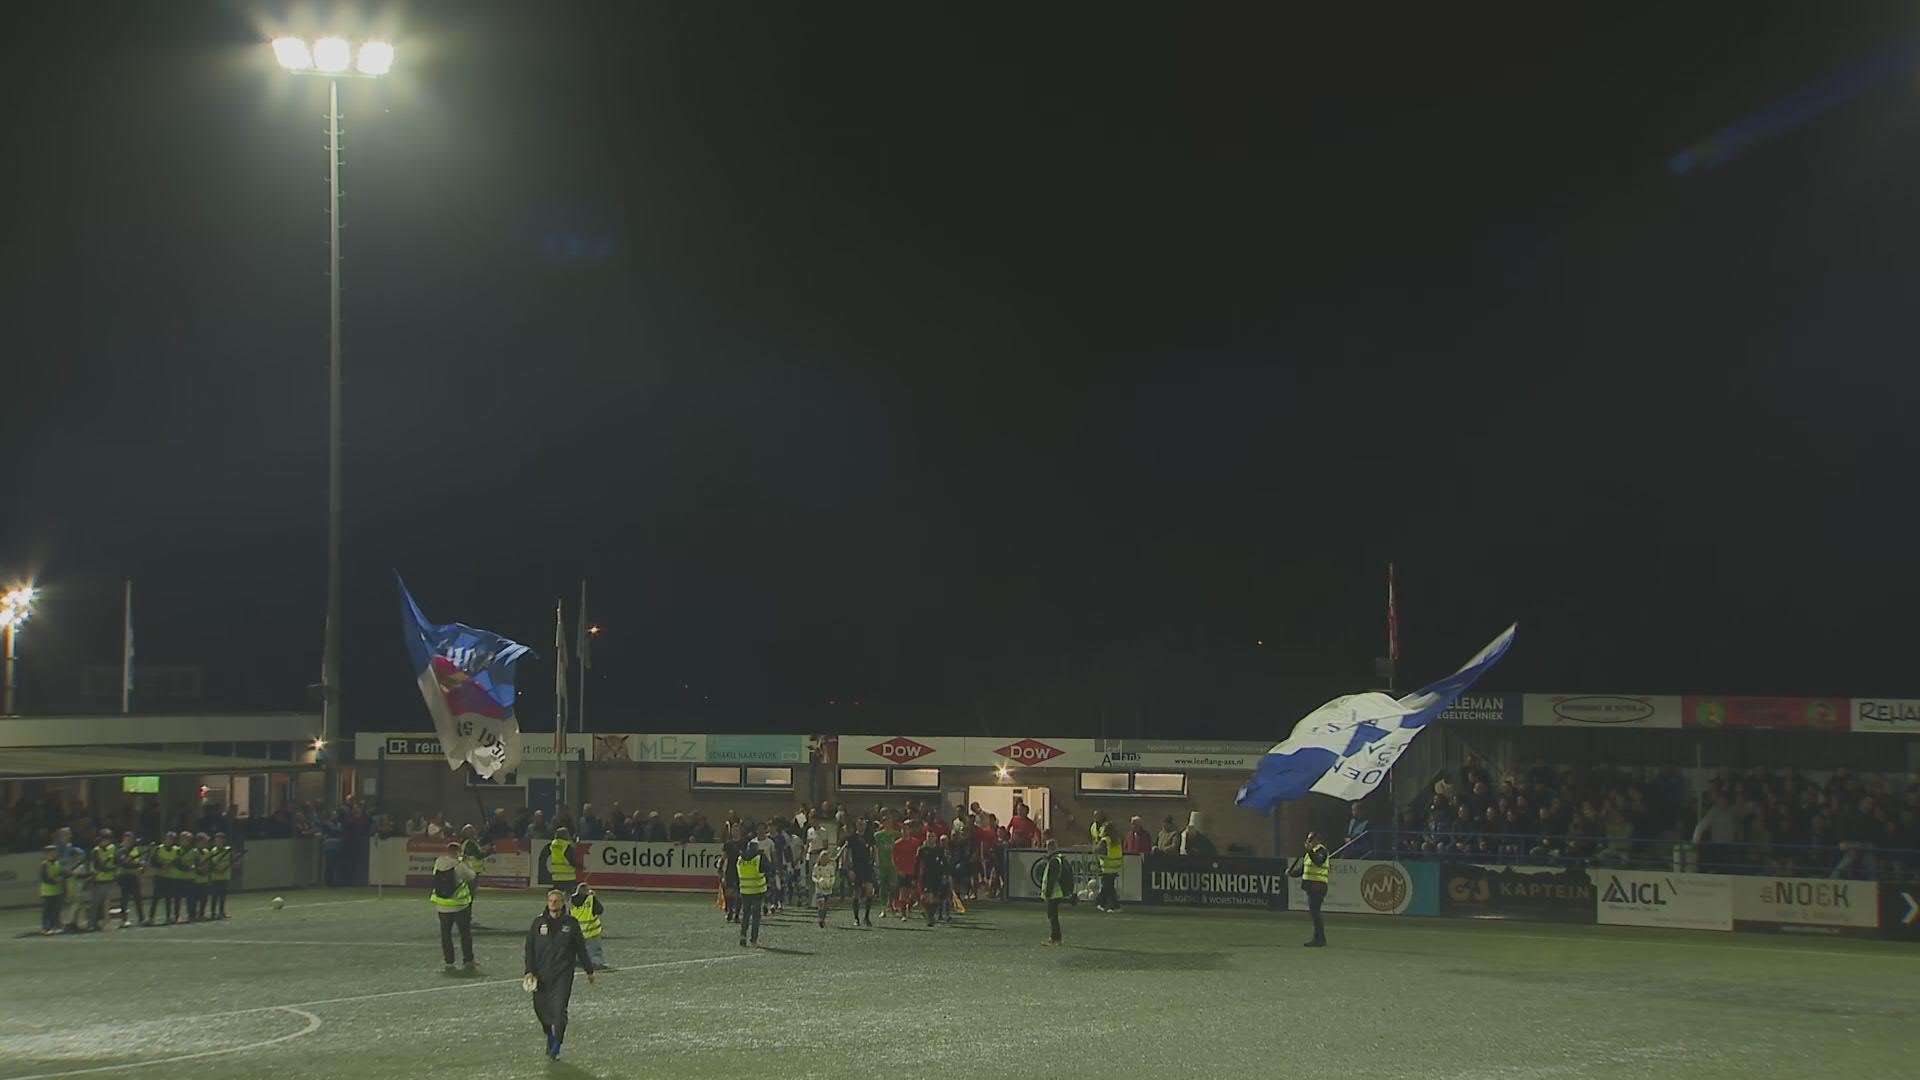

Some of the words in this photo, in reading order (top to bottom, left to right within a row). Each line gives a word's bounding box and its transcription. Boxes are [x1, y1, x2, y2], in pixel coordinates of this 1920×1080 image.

[602, 847, 674, 868] Geldof
[1152, 871, 1281, 894] LIMOUSINHOEVE
[1500, 881, 1592, 899] KAPTEIN
